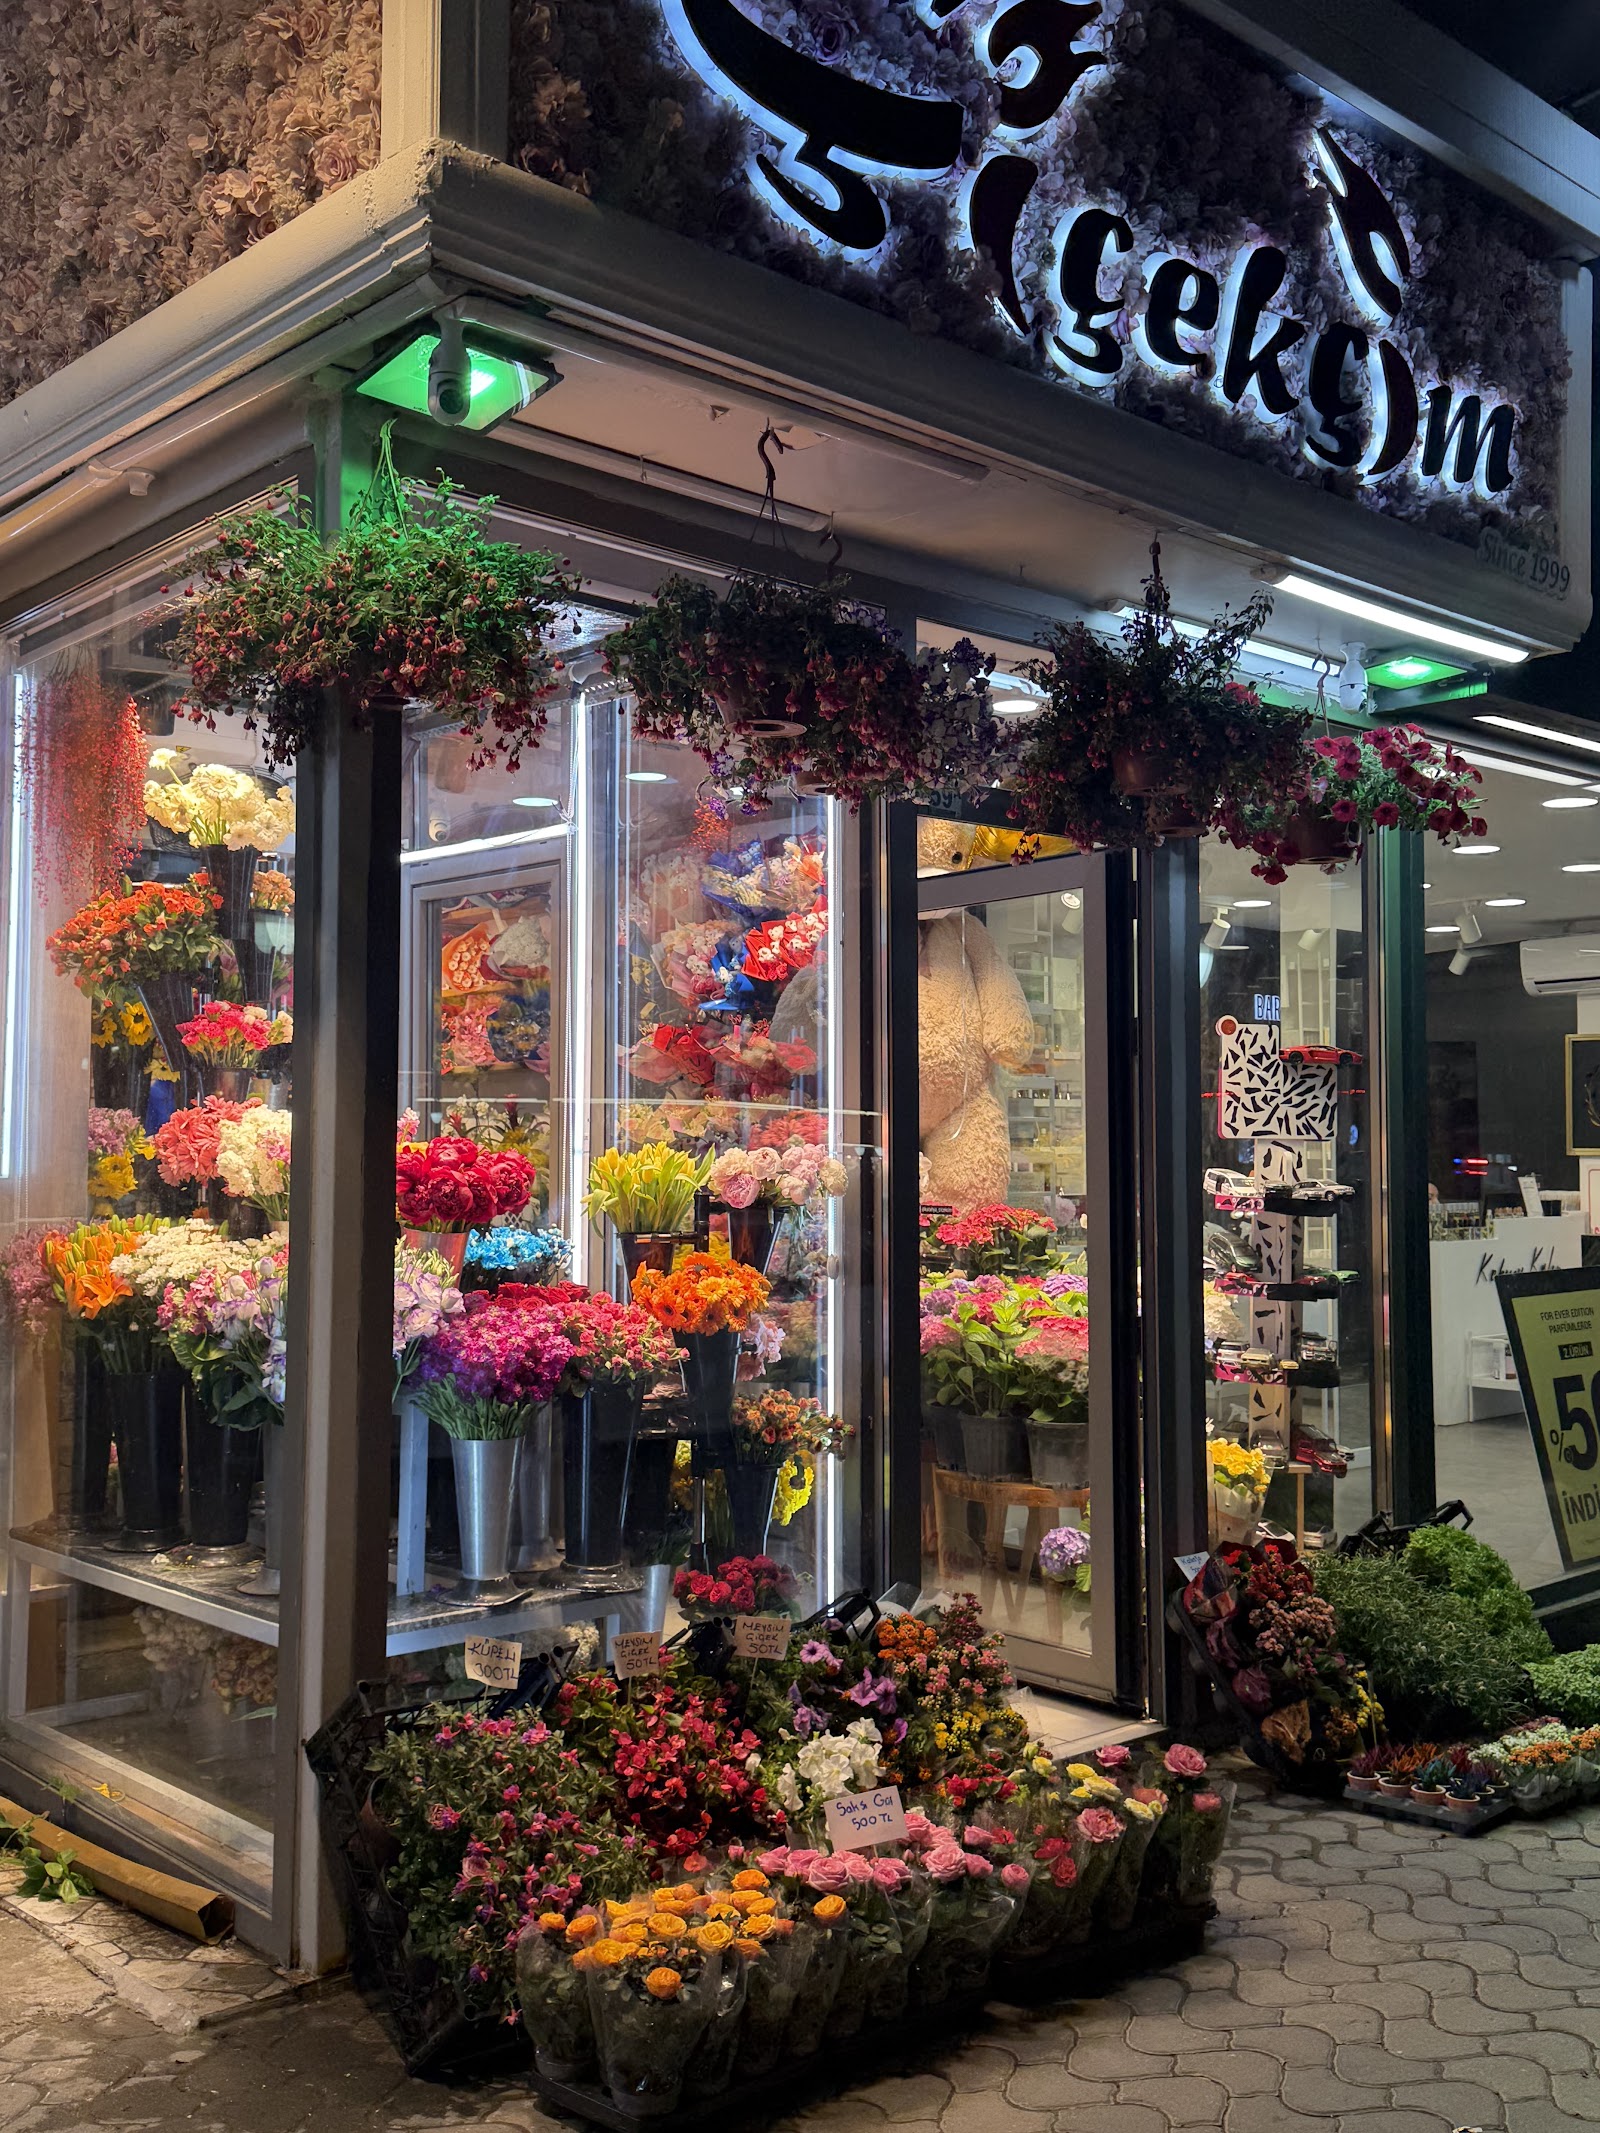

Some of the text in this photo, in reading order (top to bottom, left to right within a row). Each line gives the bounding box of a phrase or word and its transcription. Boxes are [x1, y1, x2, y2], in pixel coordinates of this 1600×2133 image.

[1482, 530, 1571, 593] Since 1999
[1540, 1307, 1594, 1321] FOR EVER EDITION
[472, 1662, 519, 1681] 300TL
[626, 1656, 657, 1670] 50TL
[851, 1812, 894, 1831] 500 TL
